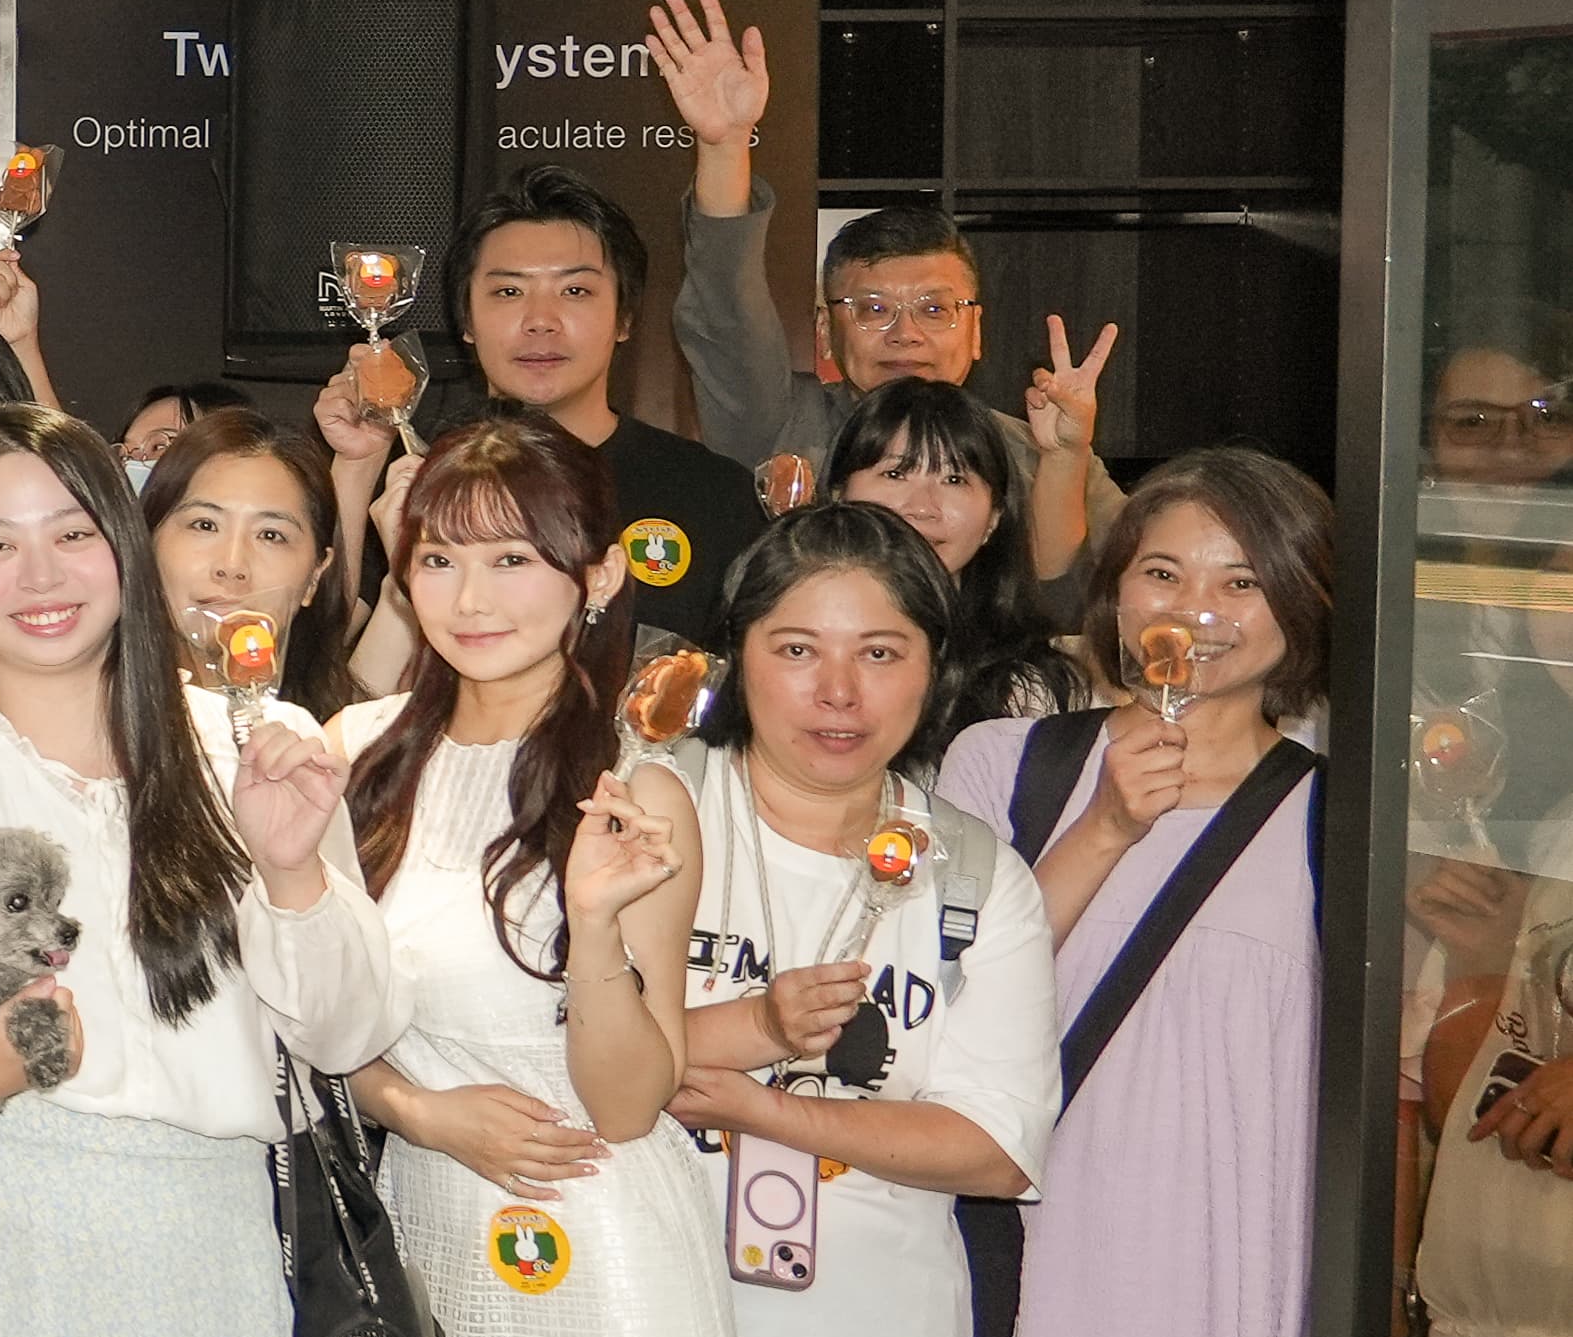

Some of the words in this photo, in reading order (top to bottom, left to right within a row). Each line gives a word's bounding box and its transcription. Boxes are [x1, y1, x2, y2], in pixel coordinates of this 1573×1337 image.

[495, 35, 664, 90] ystem
[73, 116, 210, 155] Optimal
[497, 119, 626, 149] aculate
[642, 124, 760, 149] ress
